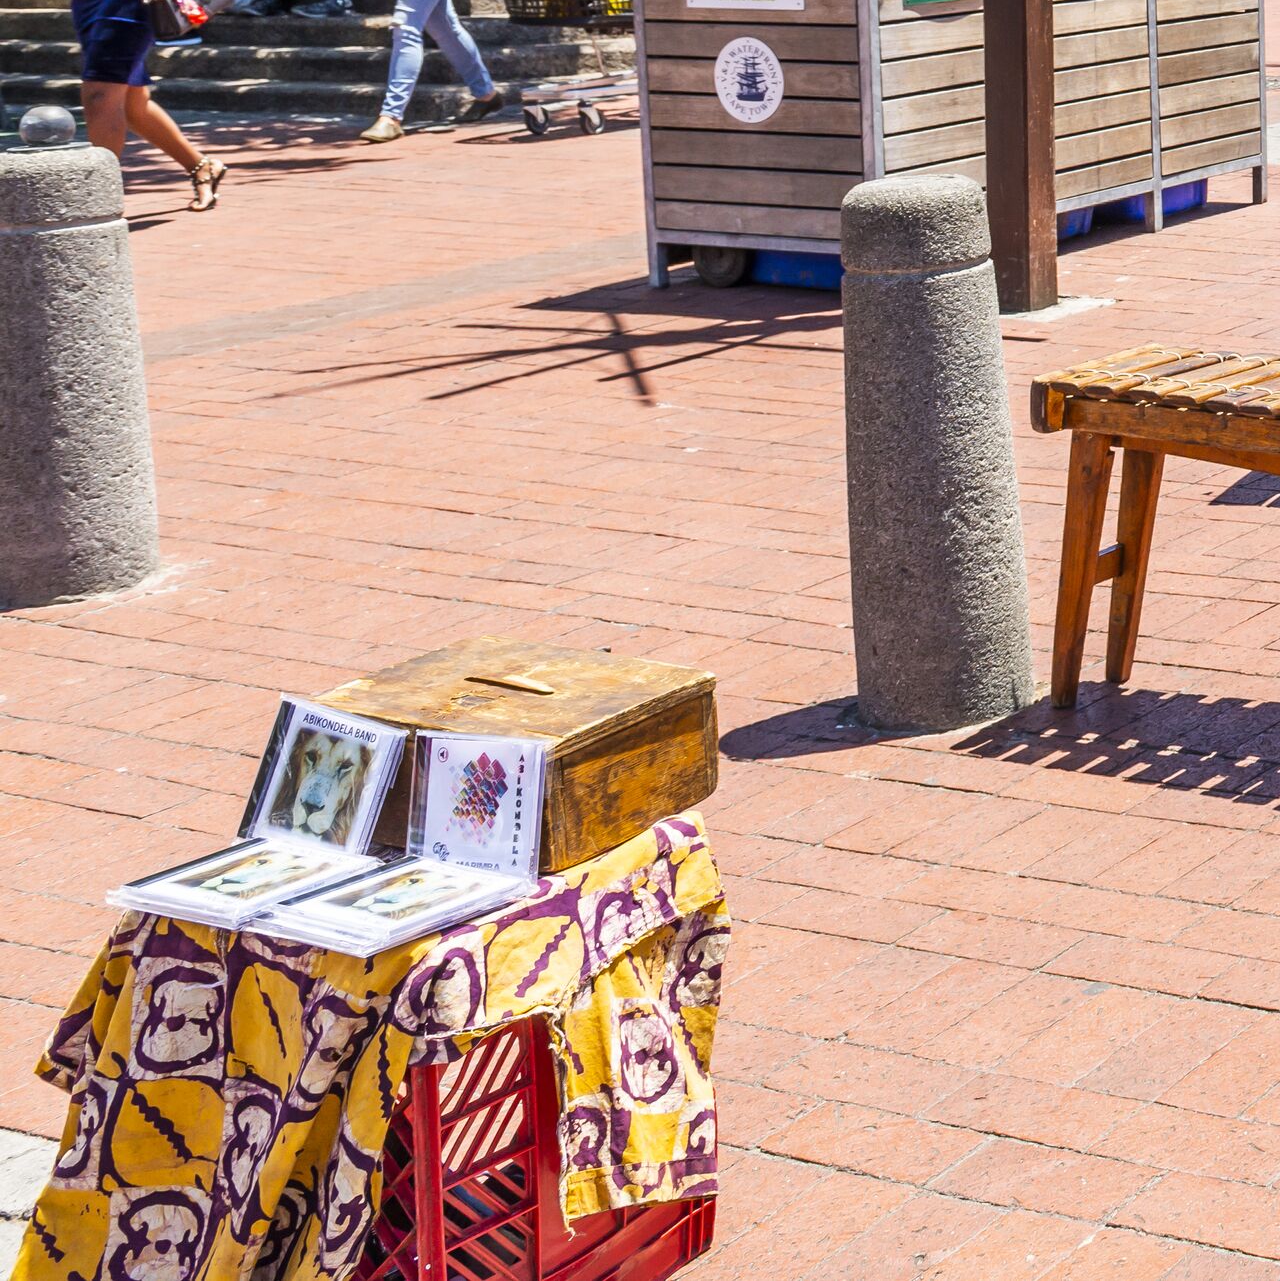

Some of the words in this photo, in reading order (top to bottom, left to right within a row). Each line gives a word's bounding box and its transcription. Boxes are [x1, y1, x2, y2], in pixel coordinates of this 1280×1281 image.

[728, 45, 777, 85] WATERFRONT
[726, 92, 747, 114] CAPE
[748, 95, 774, 115] TOWN
[303, 713, 353, 737] ABIKONDELA
[354, 728, 377, 743] BAND
